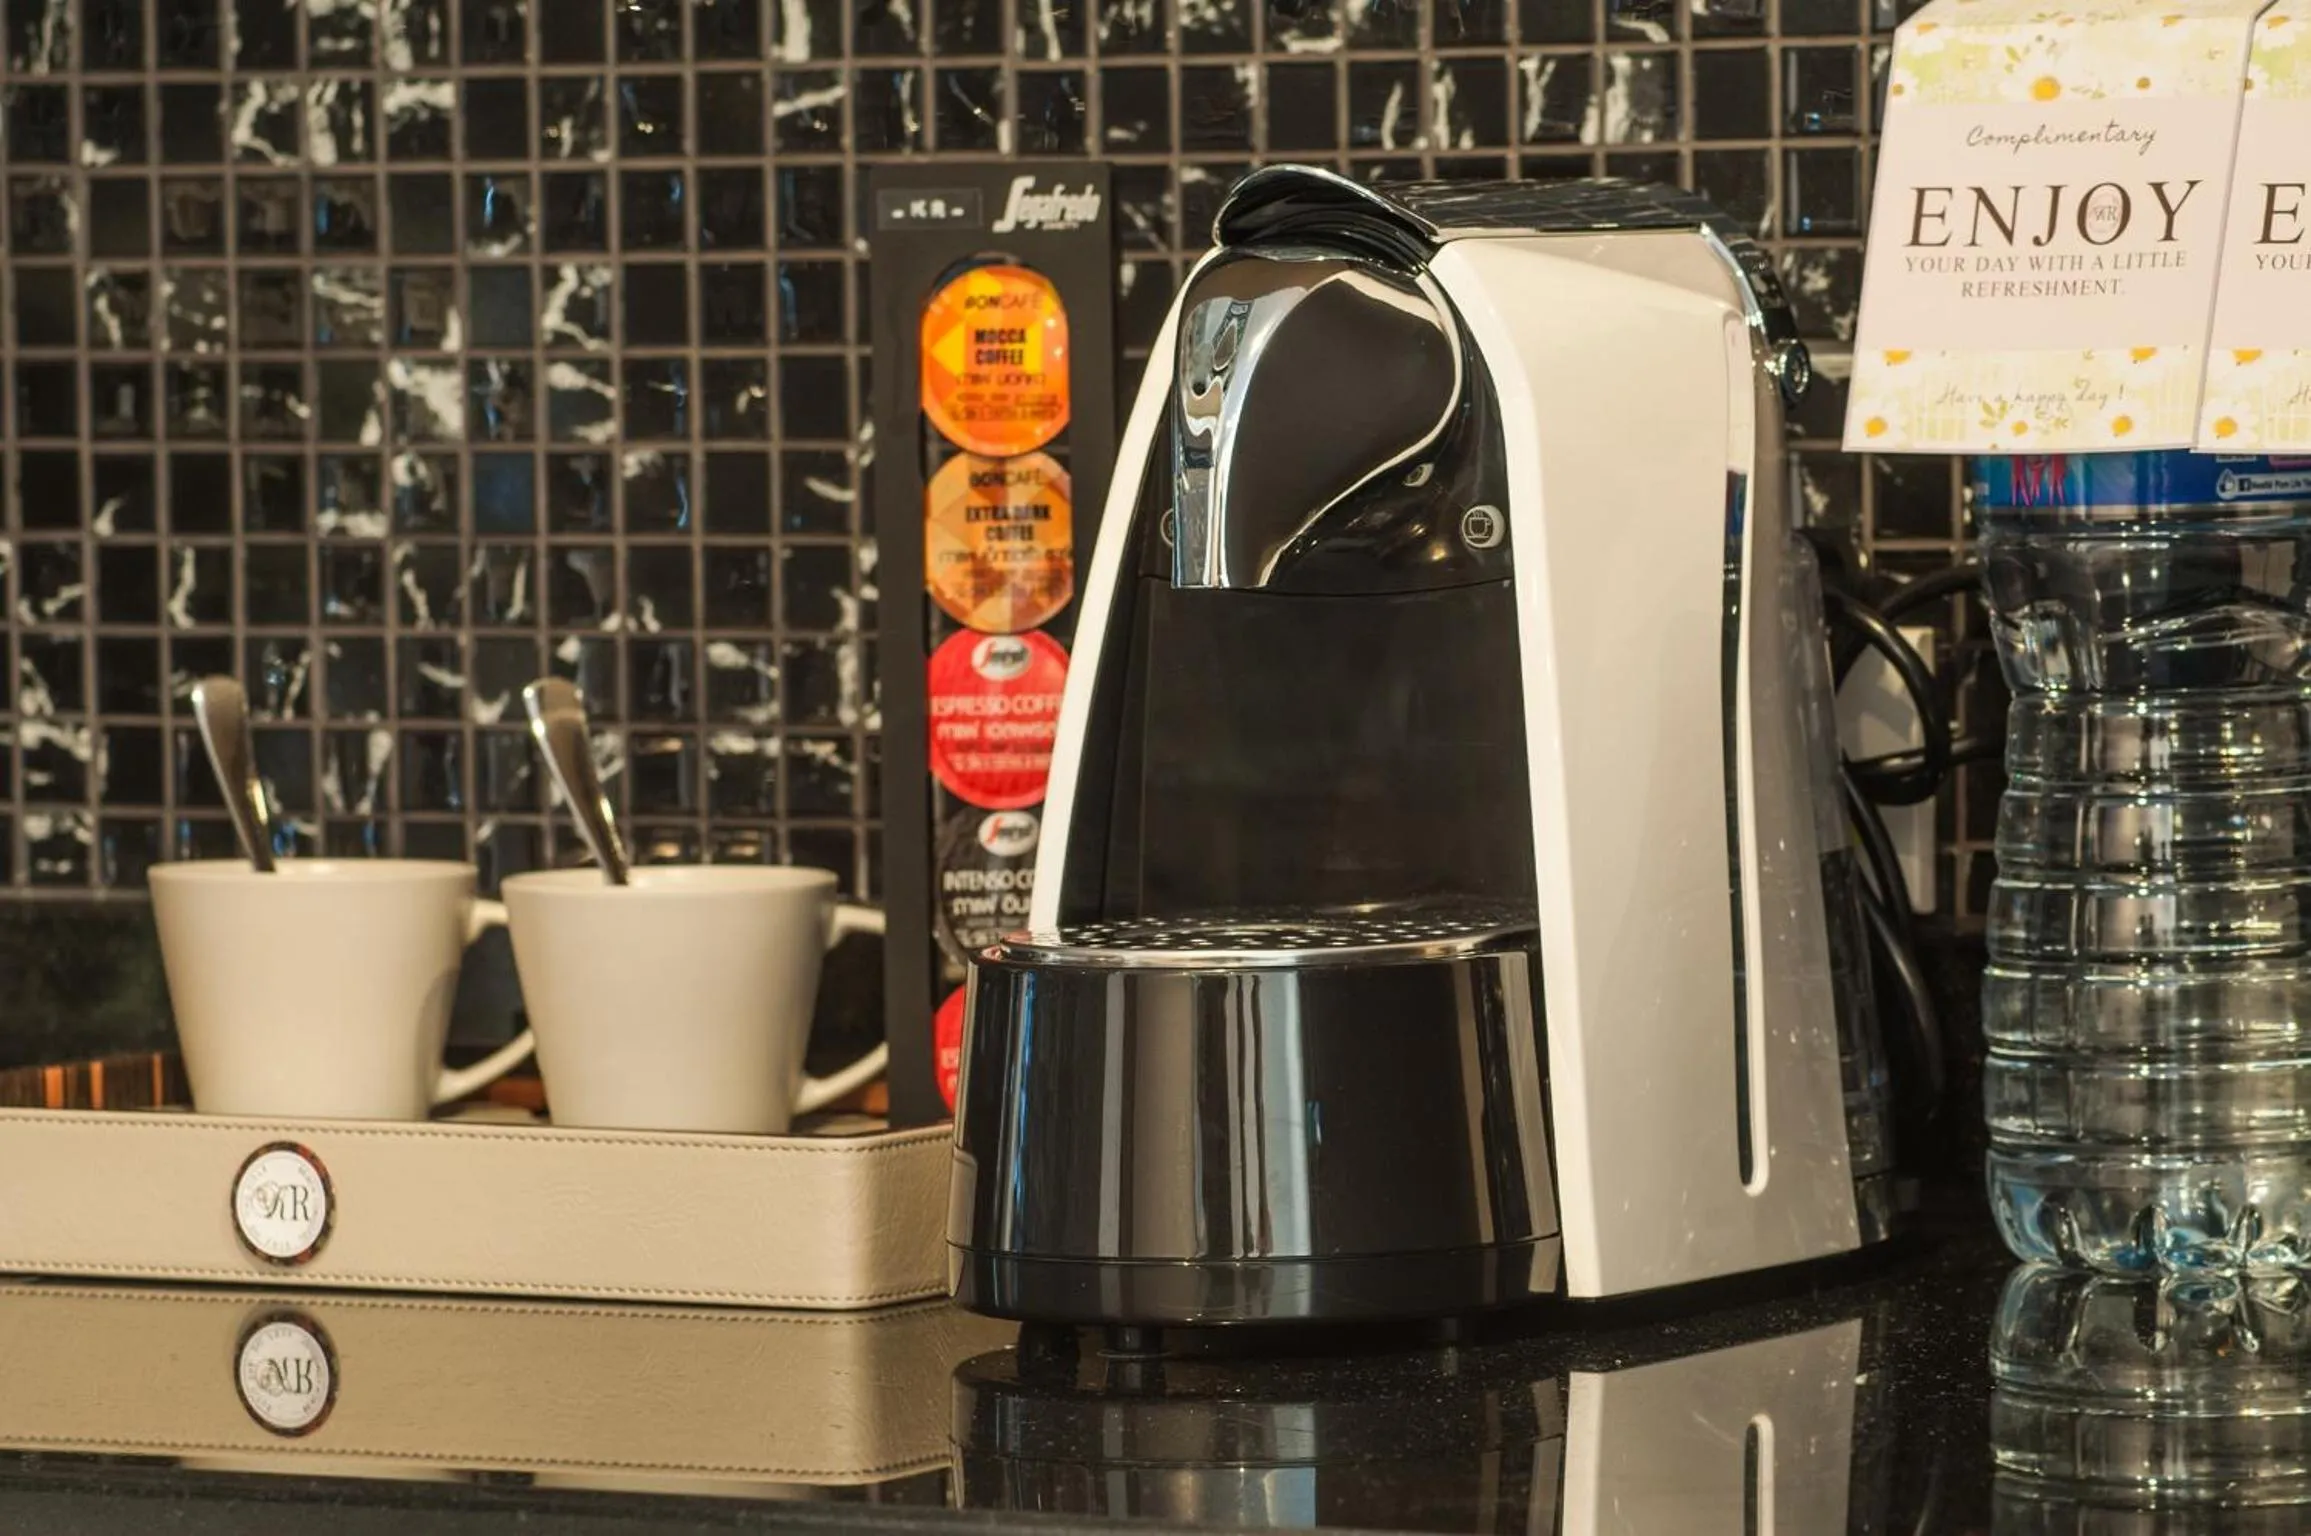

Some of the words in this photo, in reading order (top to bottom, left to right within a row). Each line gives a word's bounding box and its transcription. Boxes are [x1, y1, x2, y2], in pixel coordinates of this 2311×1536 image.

[1966, 119, 2158, 155] Complimentary
[1903, 179, 2204, 248] ENJOY
[1905, 255, 1966, 273] YOUR
[1975, 255, 2020, 272] DAY
[2028, 254, 2084, 271] WITH
[2091, 254, 2105, 270] A
[2113, 250, 2188, 269] LITTLE
